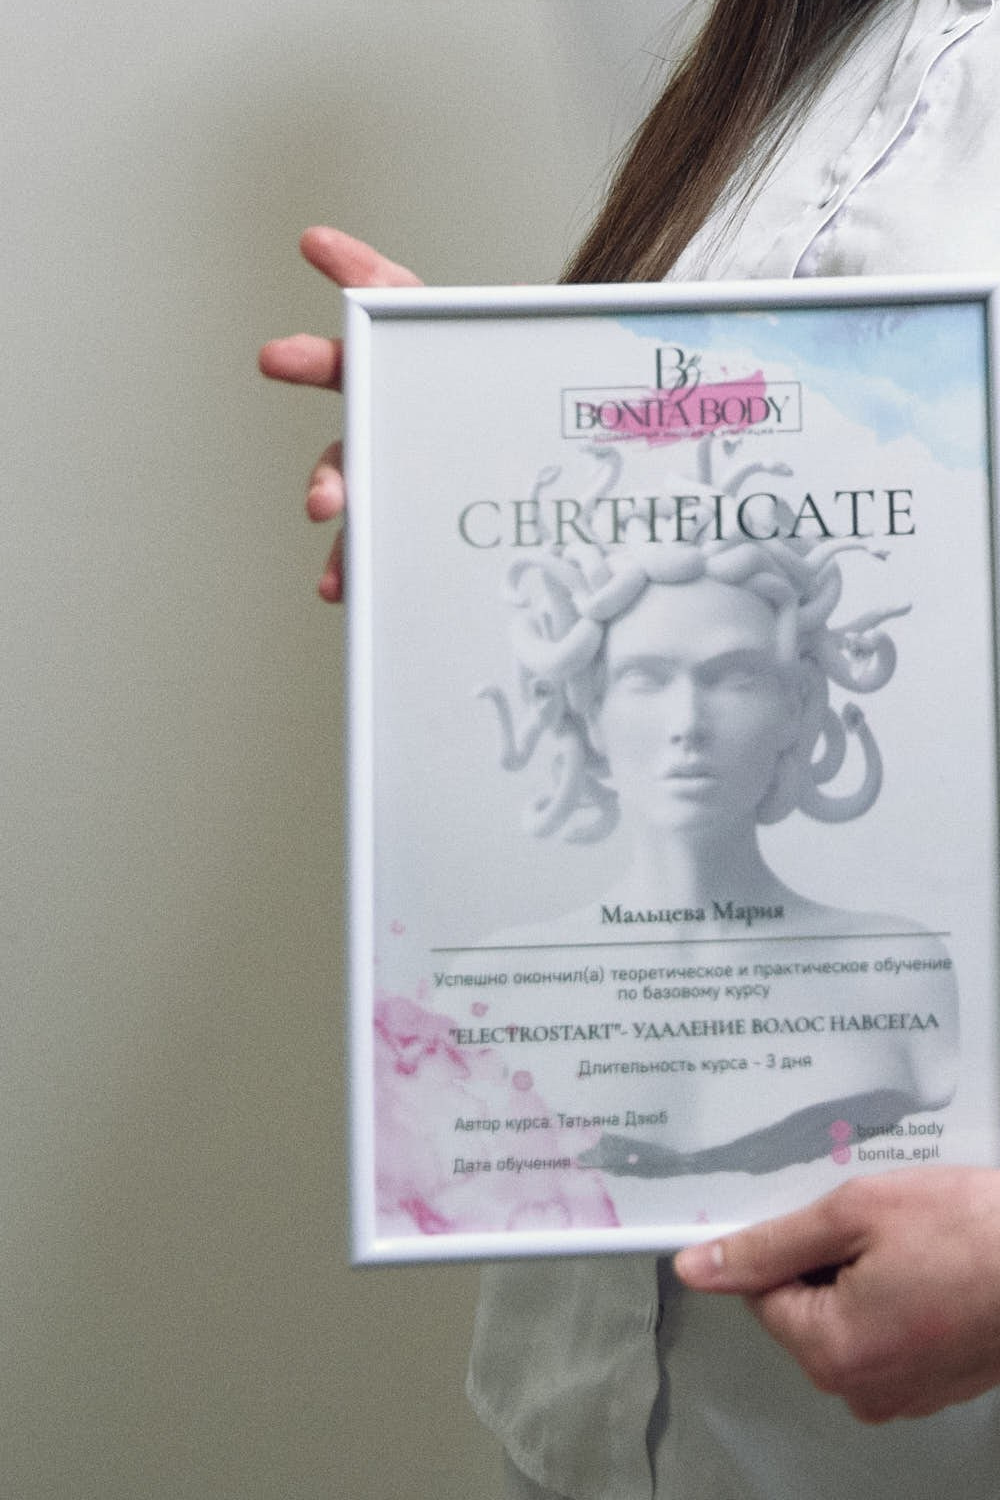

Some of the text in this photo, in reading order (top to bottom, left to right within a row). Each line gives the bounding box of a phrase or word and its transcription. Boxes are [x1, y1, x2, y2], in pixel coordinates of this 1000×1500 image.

[574, 394, 790, 431] BONITA BODY
[457, 488, 917, 550] CERTIFICATE
[600, 900, 785, 927] Мальцева Мария
[433, 956, 953, 989] Успешно окончил(а) теоретическое и практическое обучение
[617, 983, 771, 1002] по базовому курсу
[632, 1018, 746, 1041] УДАЛЕНИЕ
[751, 1016, 825, 1035] ВОЛОС
[830, 1012, 940, 1032] НАВСЕГДА
[578, 1059, 696, 1077] Длительность
[701, 1060, 749, 1075] курса
[766, 1054, 777, 1069] 3
[780, 1055, 813, 1070] дня
[454, 1116, 501, 1134] Автор
[557, 1111, 620, 1128] Татьяна
[856, 1121, 945, 1139] bonita.body
[453, 1155, 572, 1175] Дата обучения
[857, 1145, 941, 1165] bonita_epil
